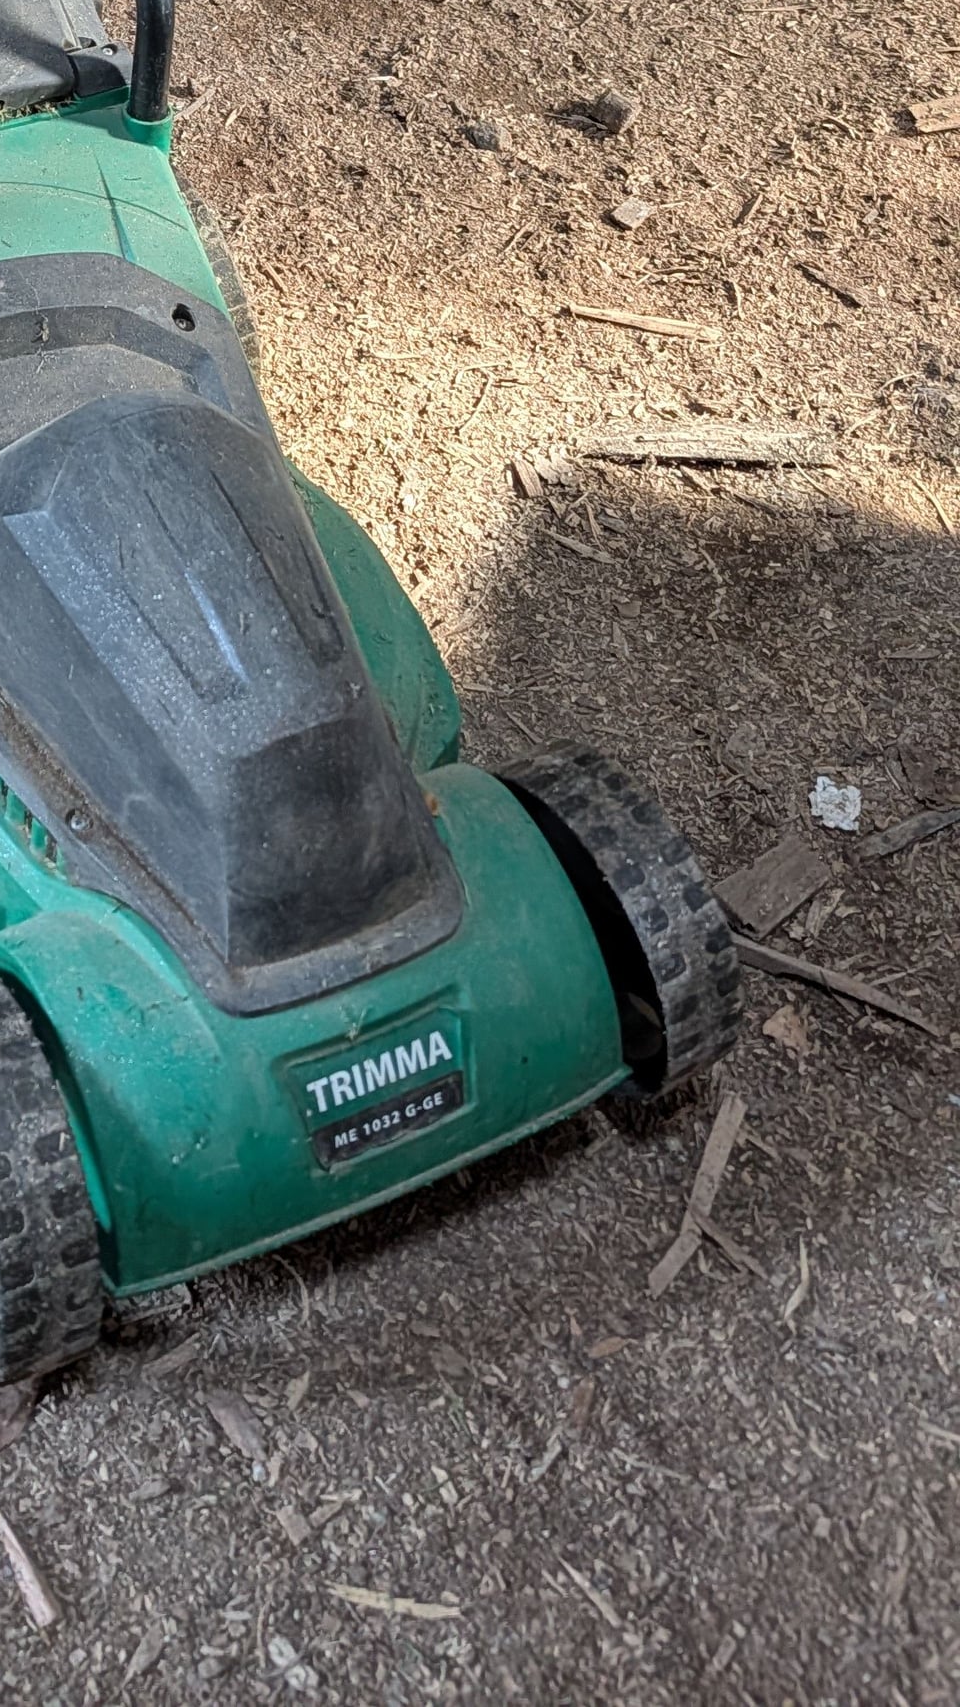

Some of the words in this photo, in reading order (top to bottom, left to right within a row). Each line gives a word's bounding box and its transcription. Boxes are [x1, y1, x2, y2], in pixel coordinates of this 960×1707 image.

[306, 1030, 453, 1113] TRIMMA
[334, 1128, 359, 1149] ME
[363, 1110, 401, 1135] 1032
[404, 1091, 444, 1118] G-GE
